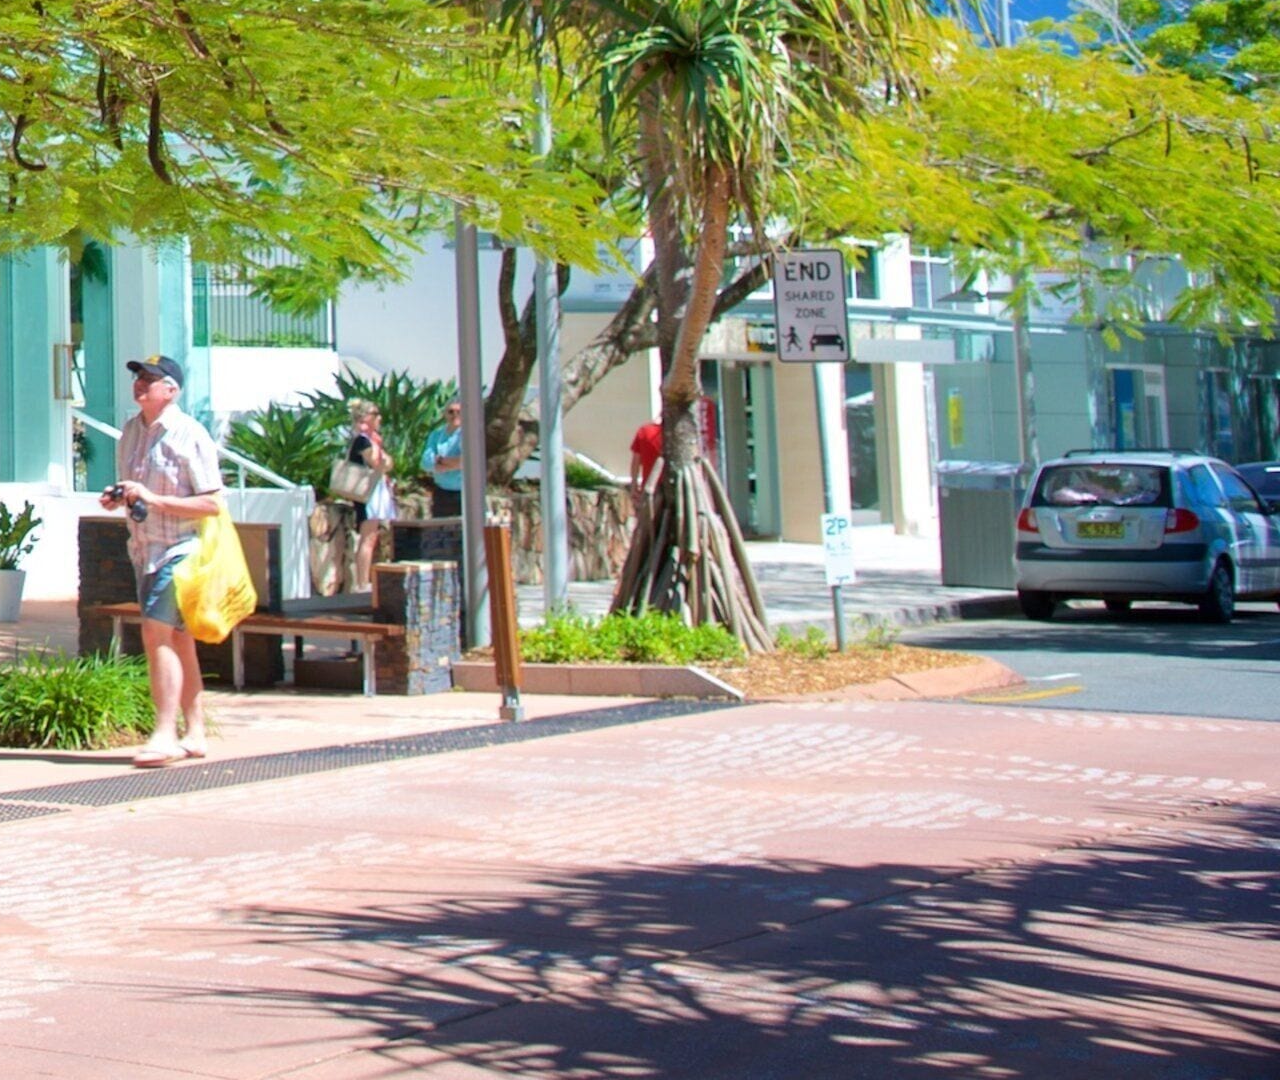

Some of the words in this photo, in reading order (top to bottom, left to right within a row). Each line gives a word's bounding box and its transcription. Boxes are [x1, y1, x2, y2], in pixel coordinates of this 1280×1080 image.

[785, 261, 831, 281] END
[784, 290, 835, 302] SHARED
[794, 307, 827, 319] ZONE
[826, 518, 848, 535] 2P
